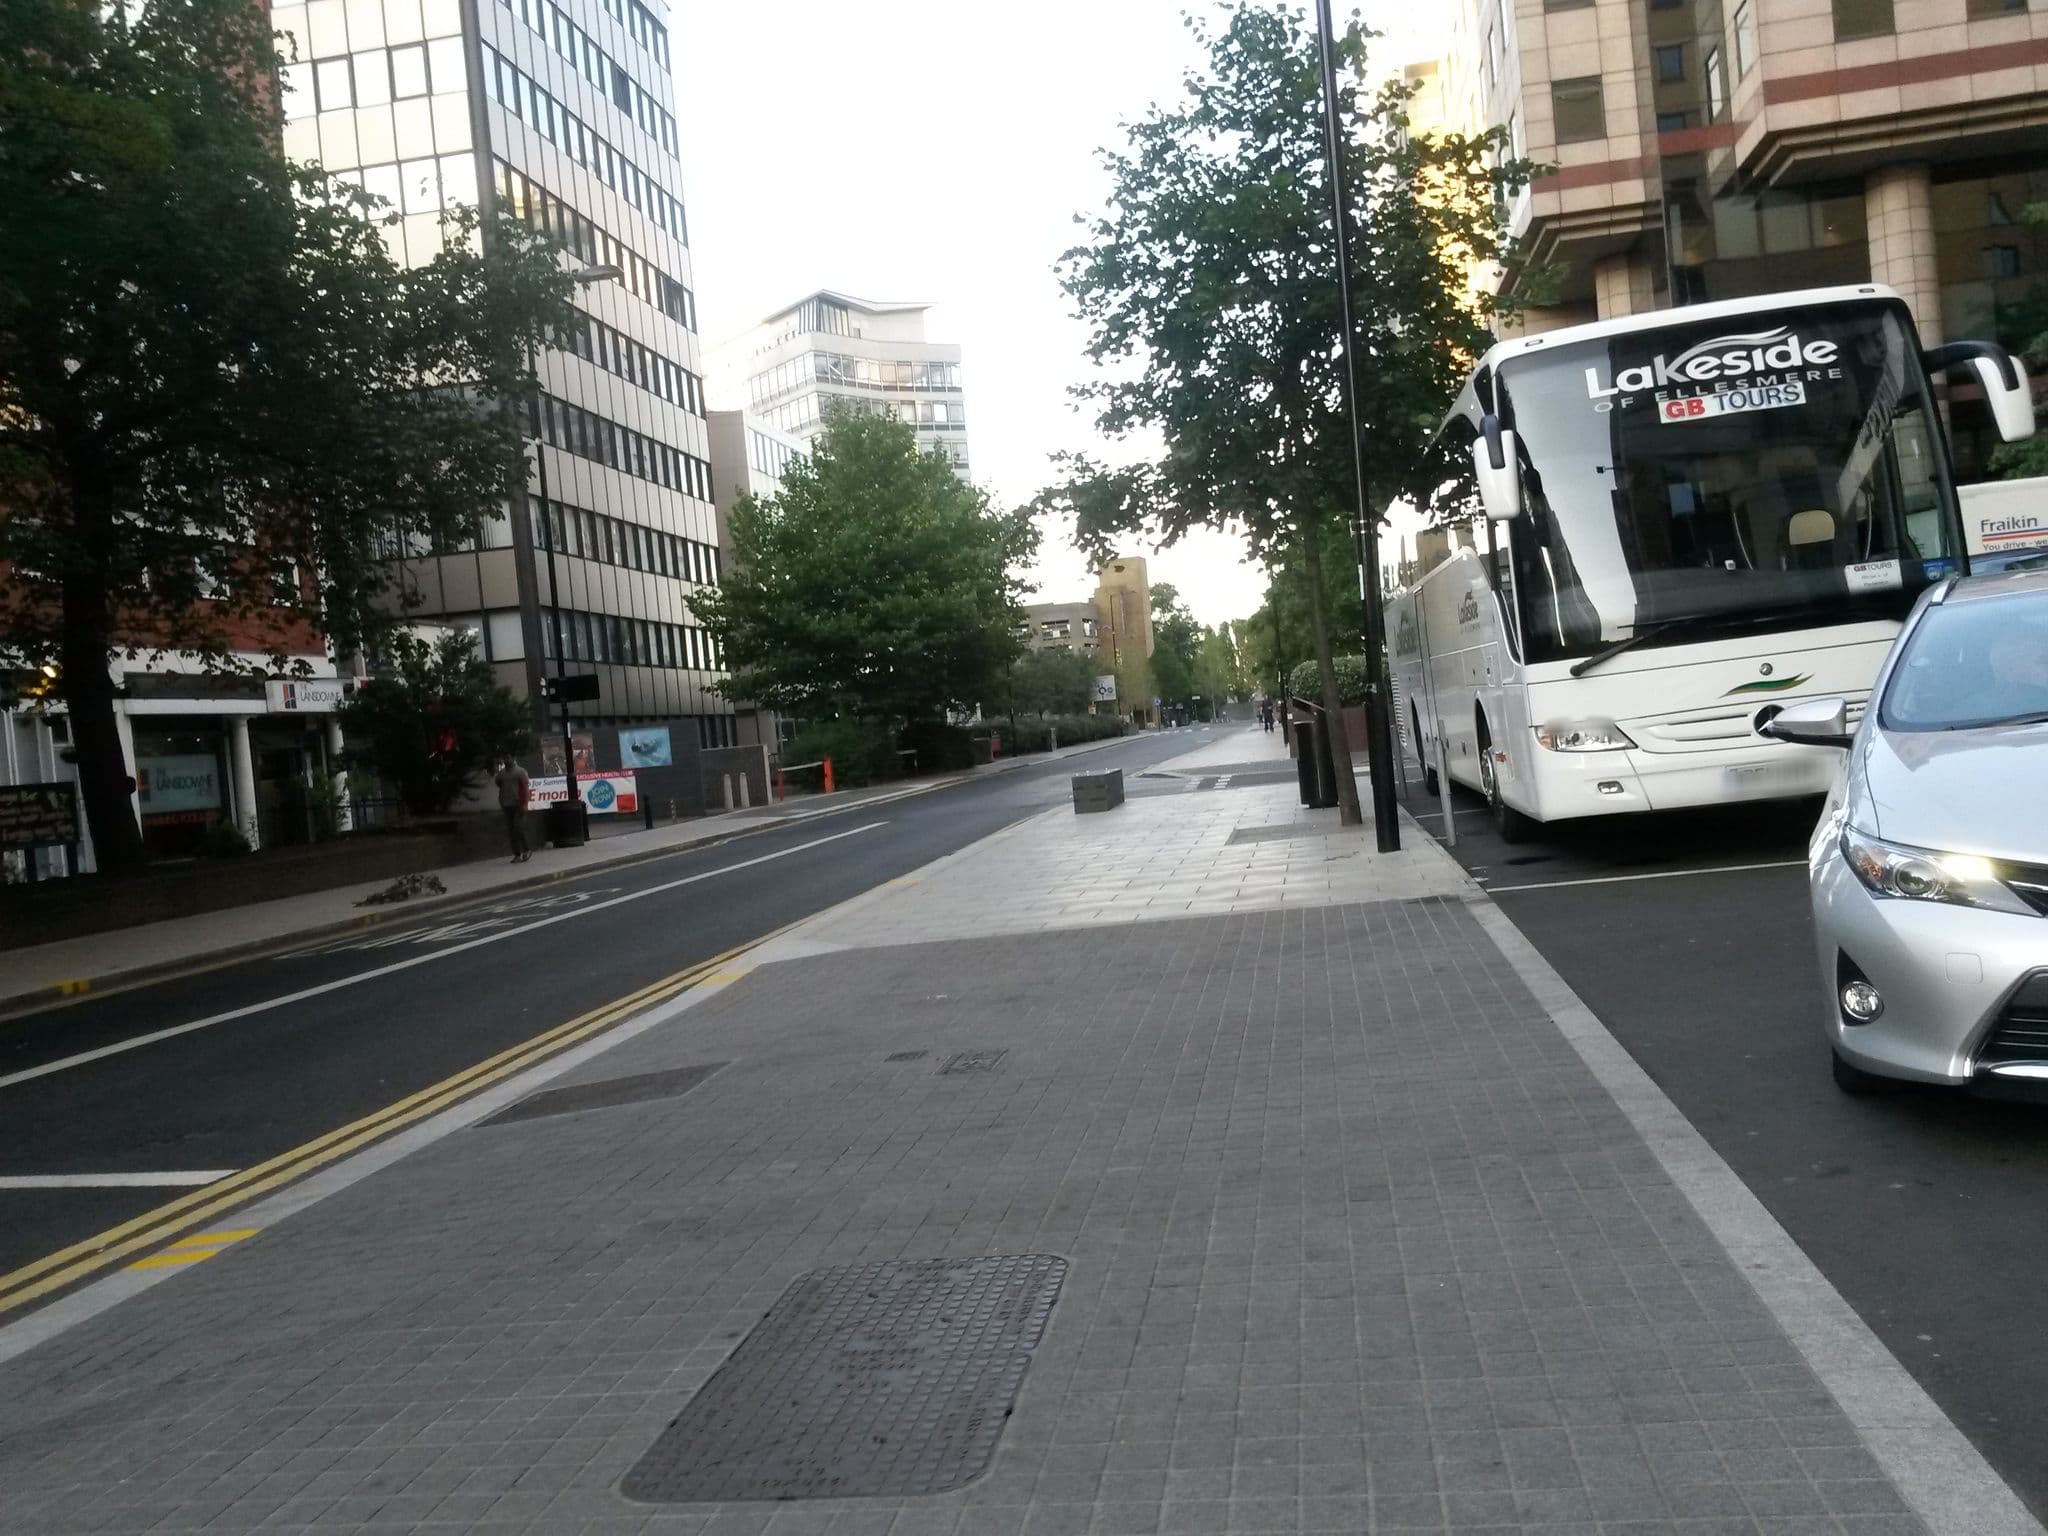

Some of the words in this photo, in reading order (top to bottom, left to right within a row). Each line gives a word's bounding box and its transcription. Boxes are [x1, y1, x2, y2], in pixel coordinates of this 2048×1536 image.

[1584, 331, 1838, 399] Lakeside
[1594, 397, 1635, 414] OF
[1655, 368, 1843, 401] ELLESMERE
[1665, 397, 1706, 419] GB
[1713, 384, 1802, 412] TOURS
[1980, 516, 2038, 533] Fraikin
[1983, 543, 2000, 552] You
[2003, 541, 2027, 551] drive
